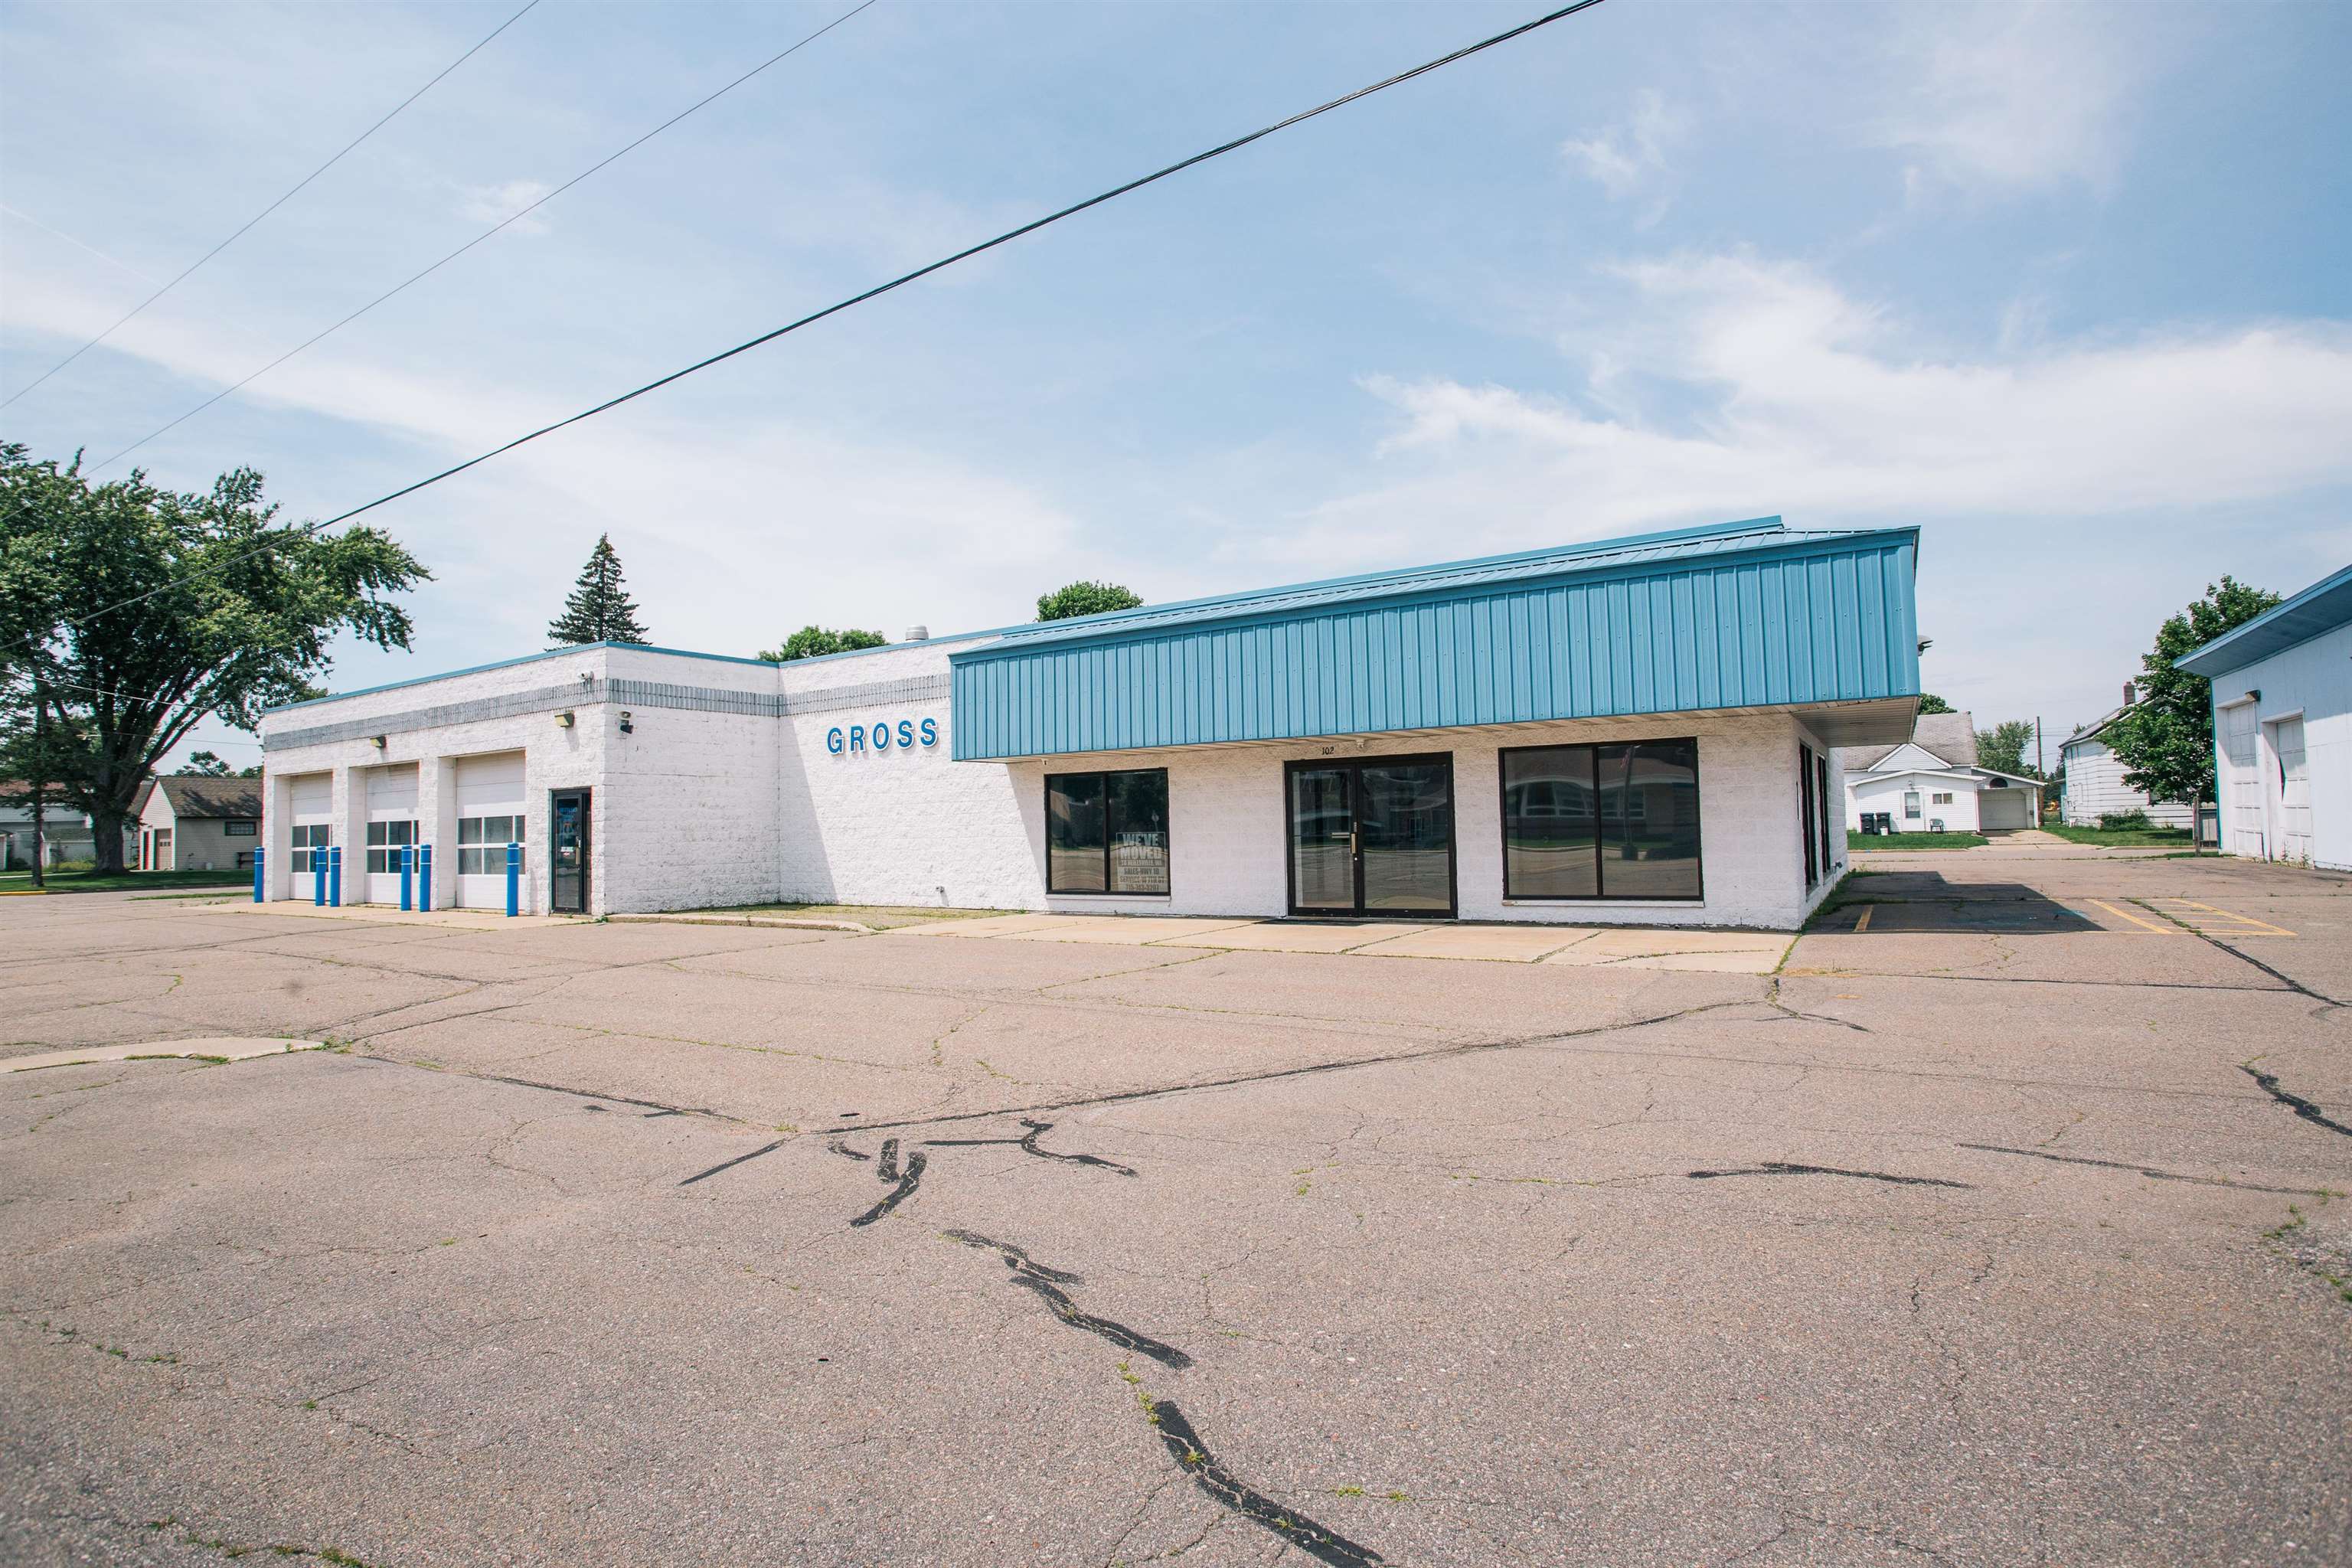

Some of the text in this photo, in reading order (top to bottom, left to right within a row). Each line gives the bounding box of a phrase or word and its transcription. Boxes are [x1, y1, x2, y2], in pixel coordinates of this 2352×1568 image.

[827, 717, 938, 755] GROSS
[1321, 746, 1334, 755] 102
[1122, 833, 1158, 846] WE'VE
[1120, 846, 1162, 859] MOVED
